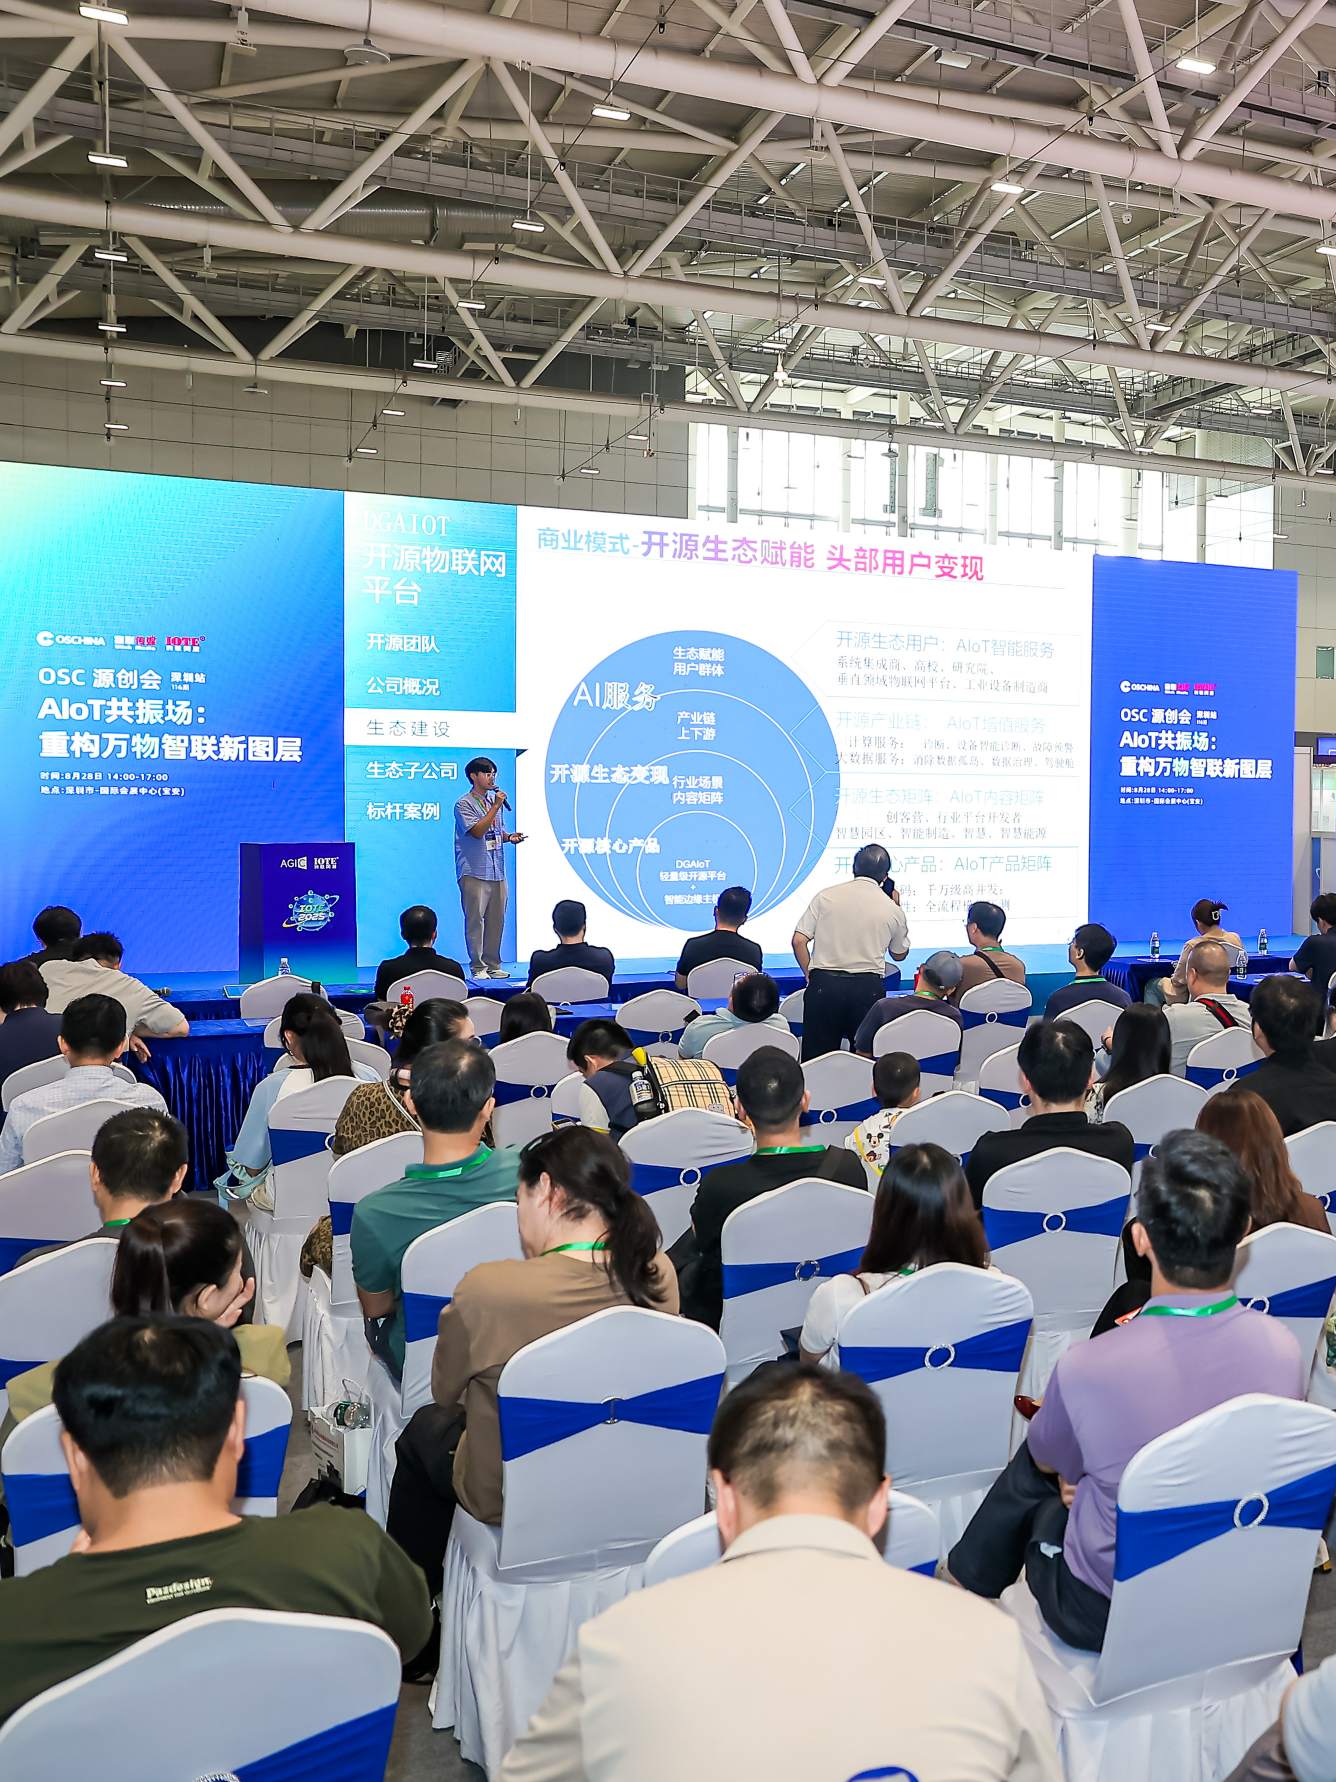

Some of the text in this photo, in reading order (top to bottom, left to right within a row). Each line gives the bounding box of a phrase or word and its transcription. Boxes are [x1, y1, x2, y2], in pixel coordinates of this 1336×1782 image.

[363, 510, 450, 537] DGAIOT
[363, 543, 506, 577] 开源物联网
[537, 526, 985, 581] 商业模式-开源生态赋能 头部用户变现
[362, 575, 422, 606] 平台
[55, 635, 106, 646] OSCHINA
[366, 633, 440, 653] 开源团队
[673, 646, 725, 661] 生态赋能
[673, 662, 725, 677] 用户群体
[38, 668, 86, 686] OSC
[92, 668, 162, 690] 源创会
[366, 677, 440, 695] 公司概况
[573, 681, 660, 711] AI服务
[677, 711, 716, 725] 产业链
[1120, 709, 1149, 722] OSC
[1151, 708, 1192, 725] 源创会
[366, 719, 450, 738] 生态建设
[677, 727, 716, 741] 上下游
[39, 730, 302, 763] 重构万物智联新图层
[366, 761, 457, 780] 生态子公司
[550, 763, 670, 785] 开源生态变现
[1120, 756, 1273, 779] 重构万物智联新图层
[107, 773, 169, 782] 14:00-17:00
[673, 775, 723, 790] 行业场景
[673, 791, 723, 806] 内容矩阵
[366, 802, 440, 820] 标杆案例
[561, 837, 661, 854] 开源核心产品
[675, 859, 711, 869] DGAIoT
[298, 913, 327, 921] 2025
